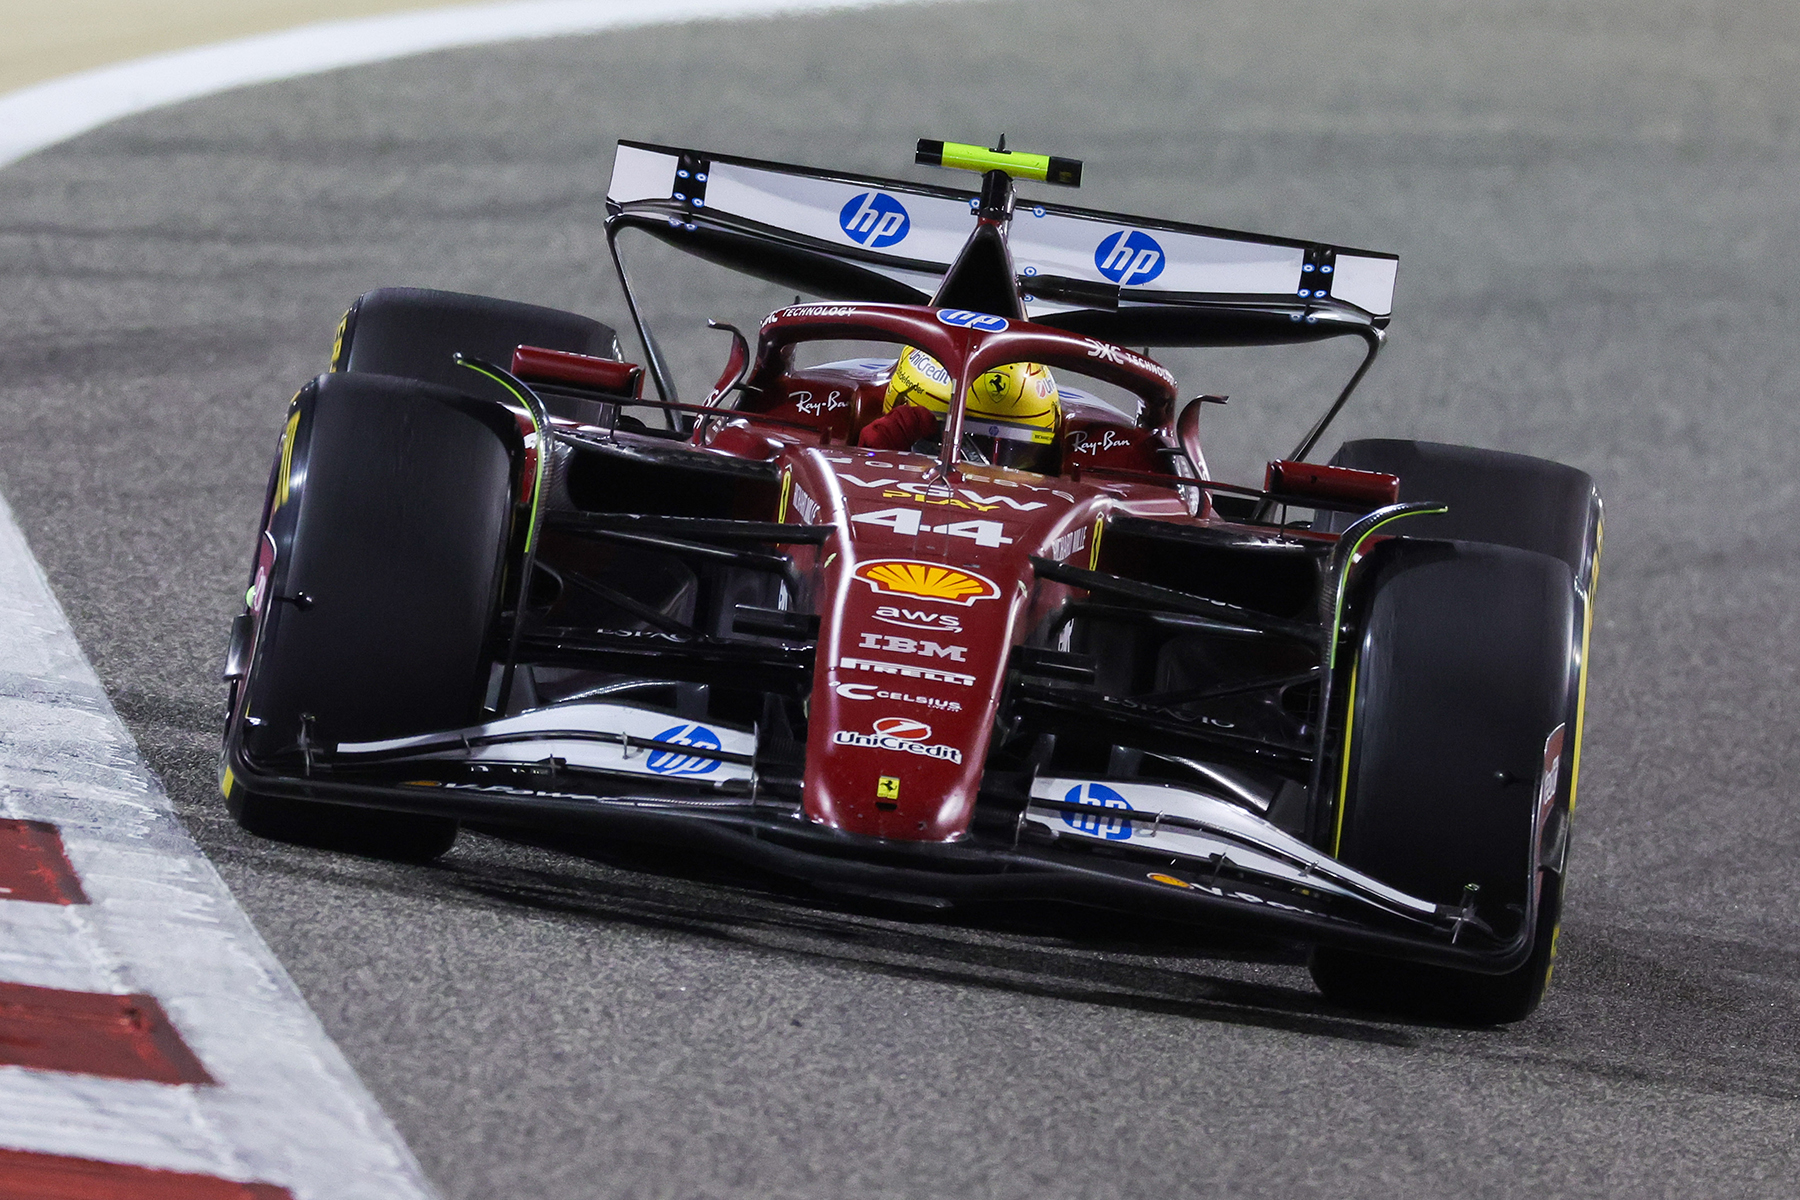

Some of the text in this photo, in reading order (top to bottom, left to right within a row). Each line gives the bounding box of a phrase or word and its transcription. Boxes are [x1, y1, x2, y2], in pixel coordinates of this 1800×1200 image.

[845, 191, 905, 248] hp
[1101, 229, 1162, 286] hp
[782, 306, 857, 318] TECHNOLOGY
[1065, 430, 1131, 456] Ray-Ban
[837, 473, 1048, 512] VGW
[882, 489, 1000, 512] PLAY
[851, 507, 1013, 548] 44
[875, 605, 960, 628] aws
[858, 632, 968, 663] IBM
[840, 657, 977, 687] PIRELLI
[651, 723, 718, 776] hp
[833, 730, 963, 765] UniCredit
[1072, 782, 1130, 841] hp
